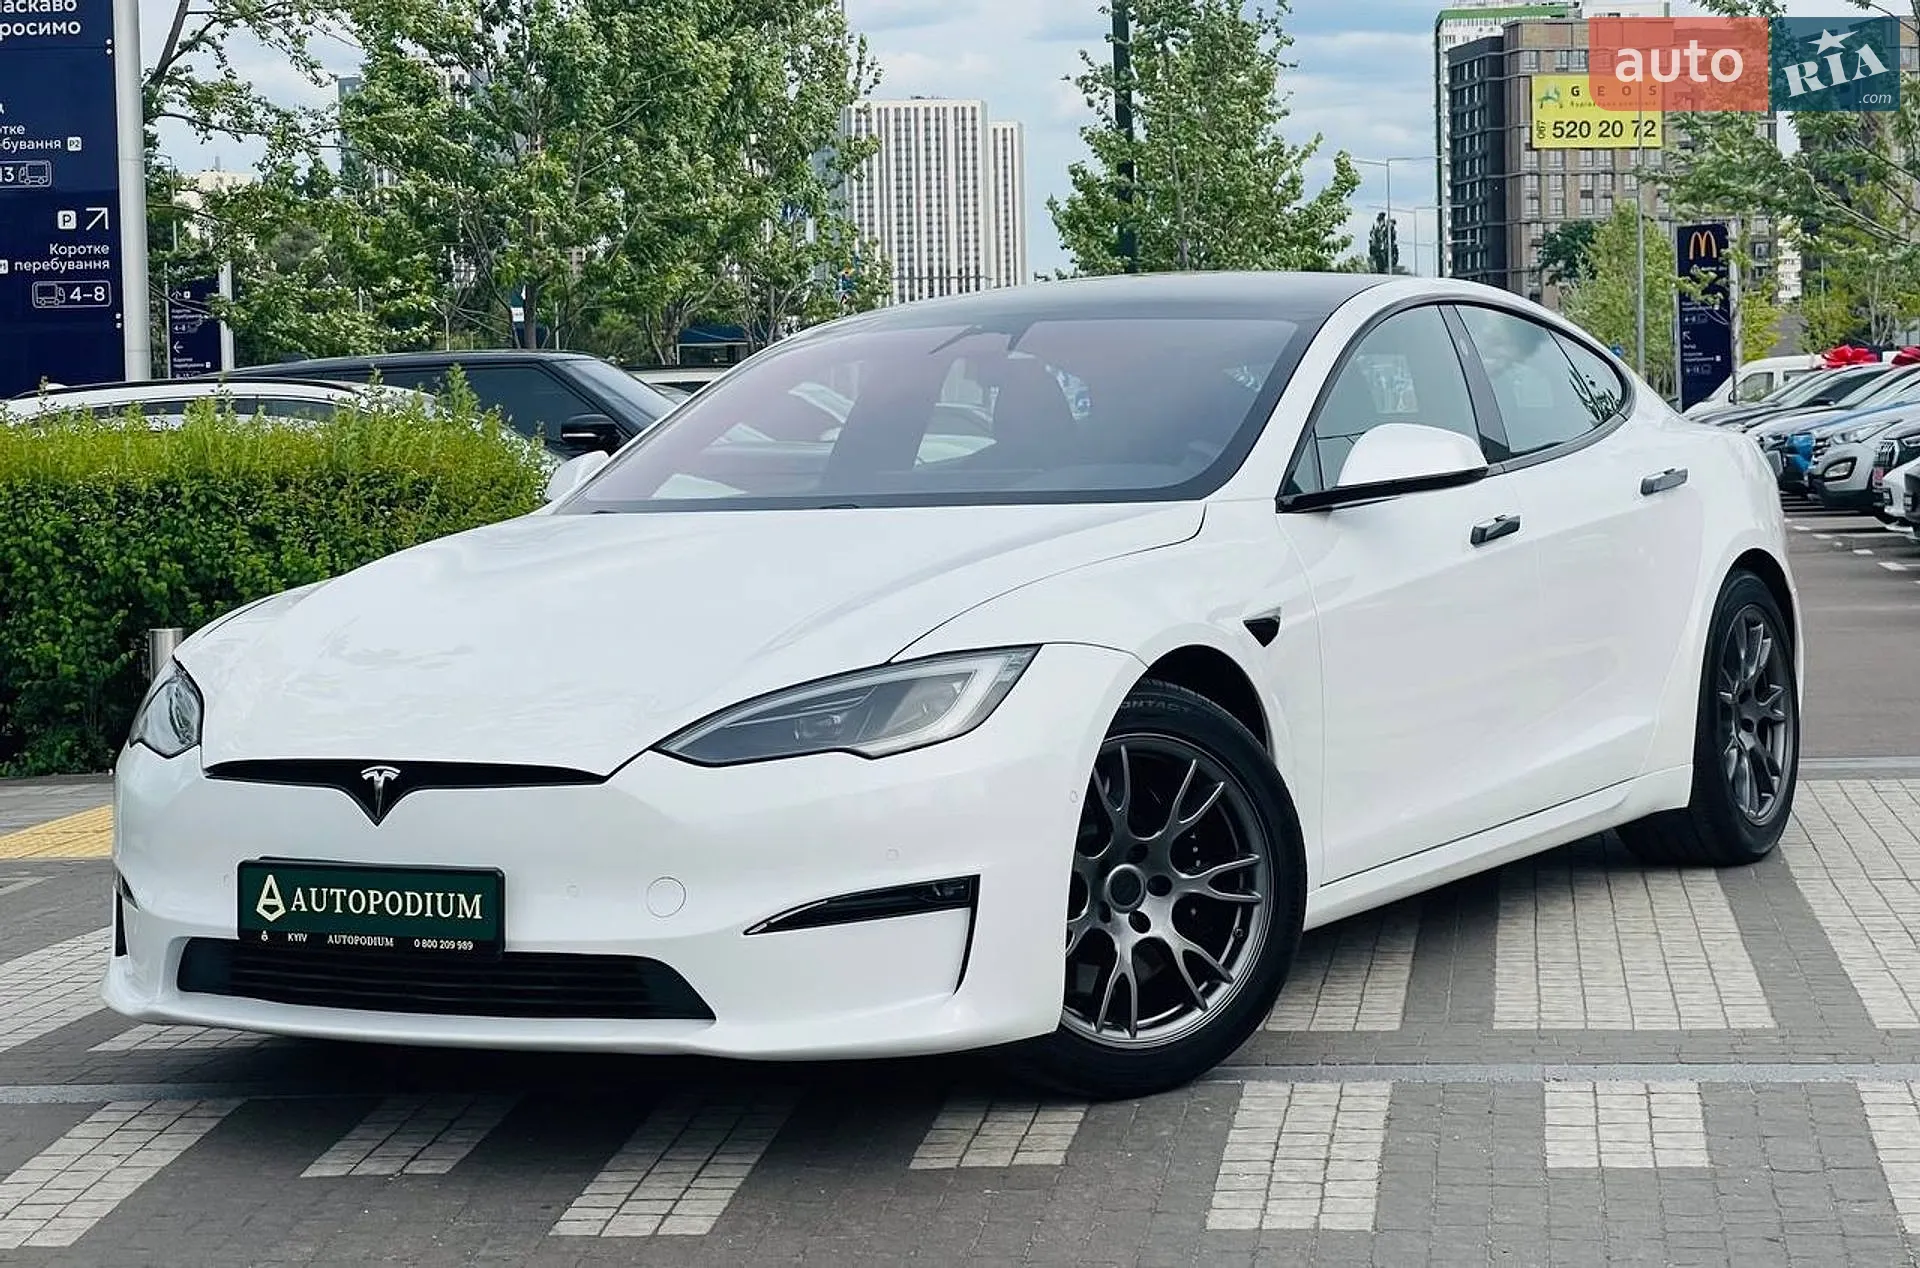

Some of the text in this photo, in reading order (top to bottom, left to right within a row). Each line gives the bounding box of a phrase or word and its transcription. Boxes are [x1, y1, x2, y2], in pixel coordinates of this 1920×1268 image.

[0, 0, 77, 13] аскаво
[1570, 85, 1657, 97] GEOS
[1552, 120, 1591, 138] 520
[1598, 120, 1623, 138] 20
[1631, 120, 1656, 138] 72
[49, 243, 110, 258] Коротке
[14, 257, 110, 274] перебування
[290, 887, 483, 920] AUTOPODIUM
[287, 932, 308, 942] KYIV
[327, 934, 395, 948] AUTOPODIUM
